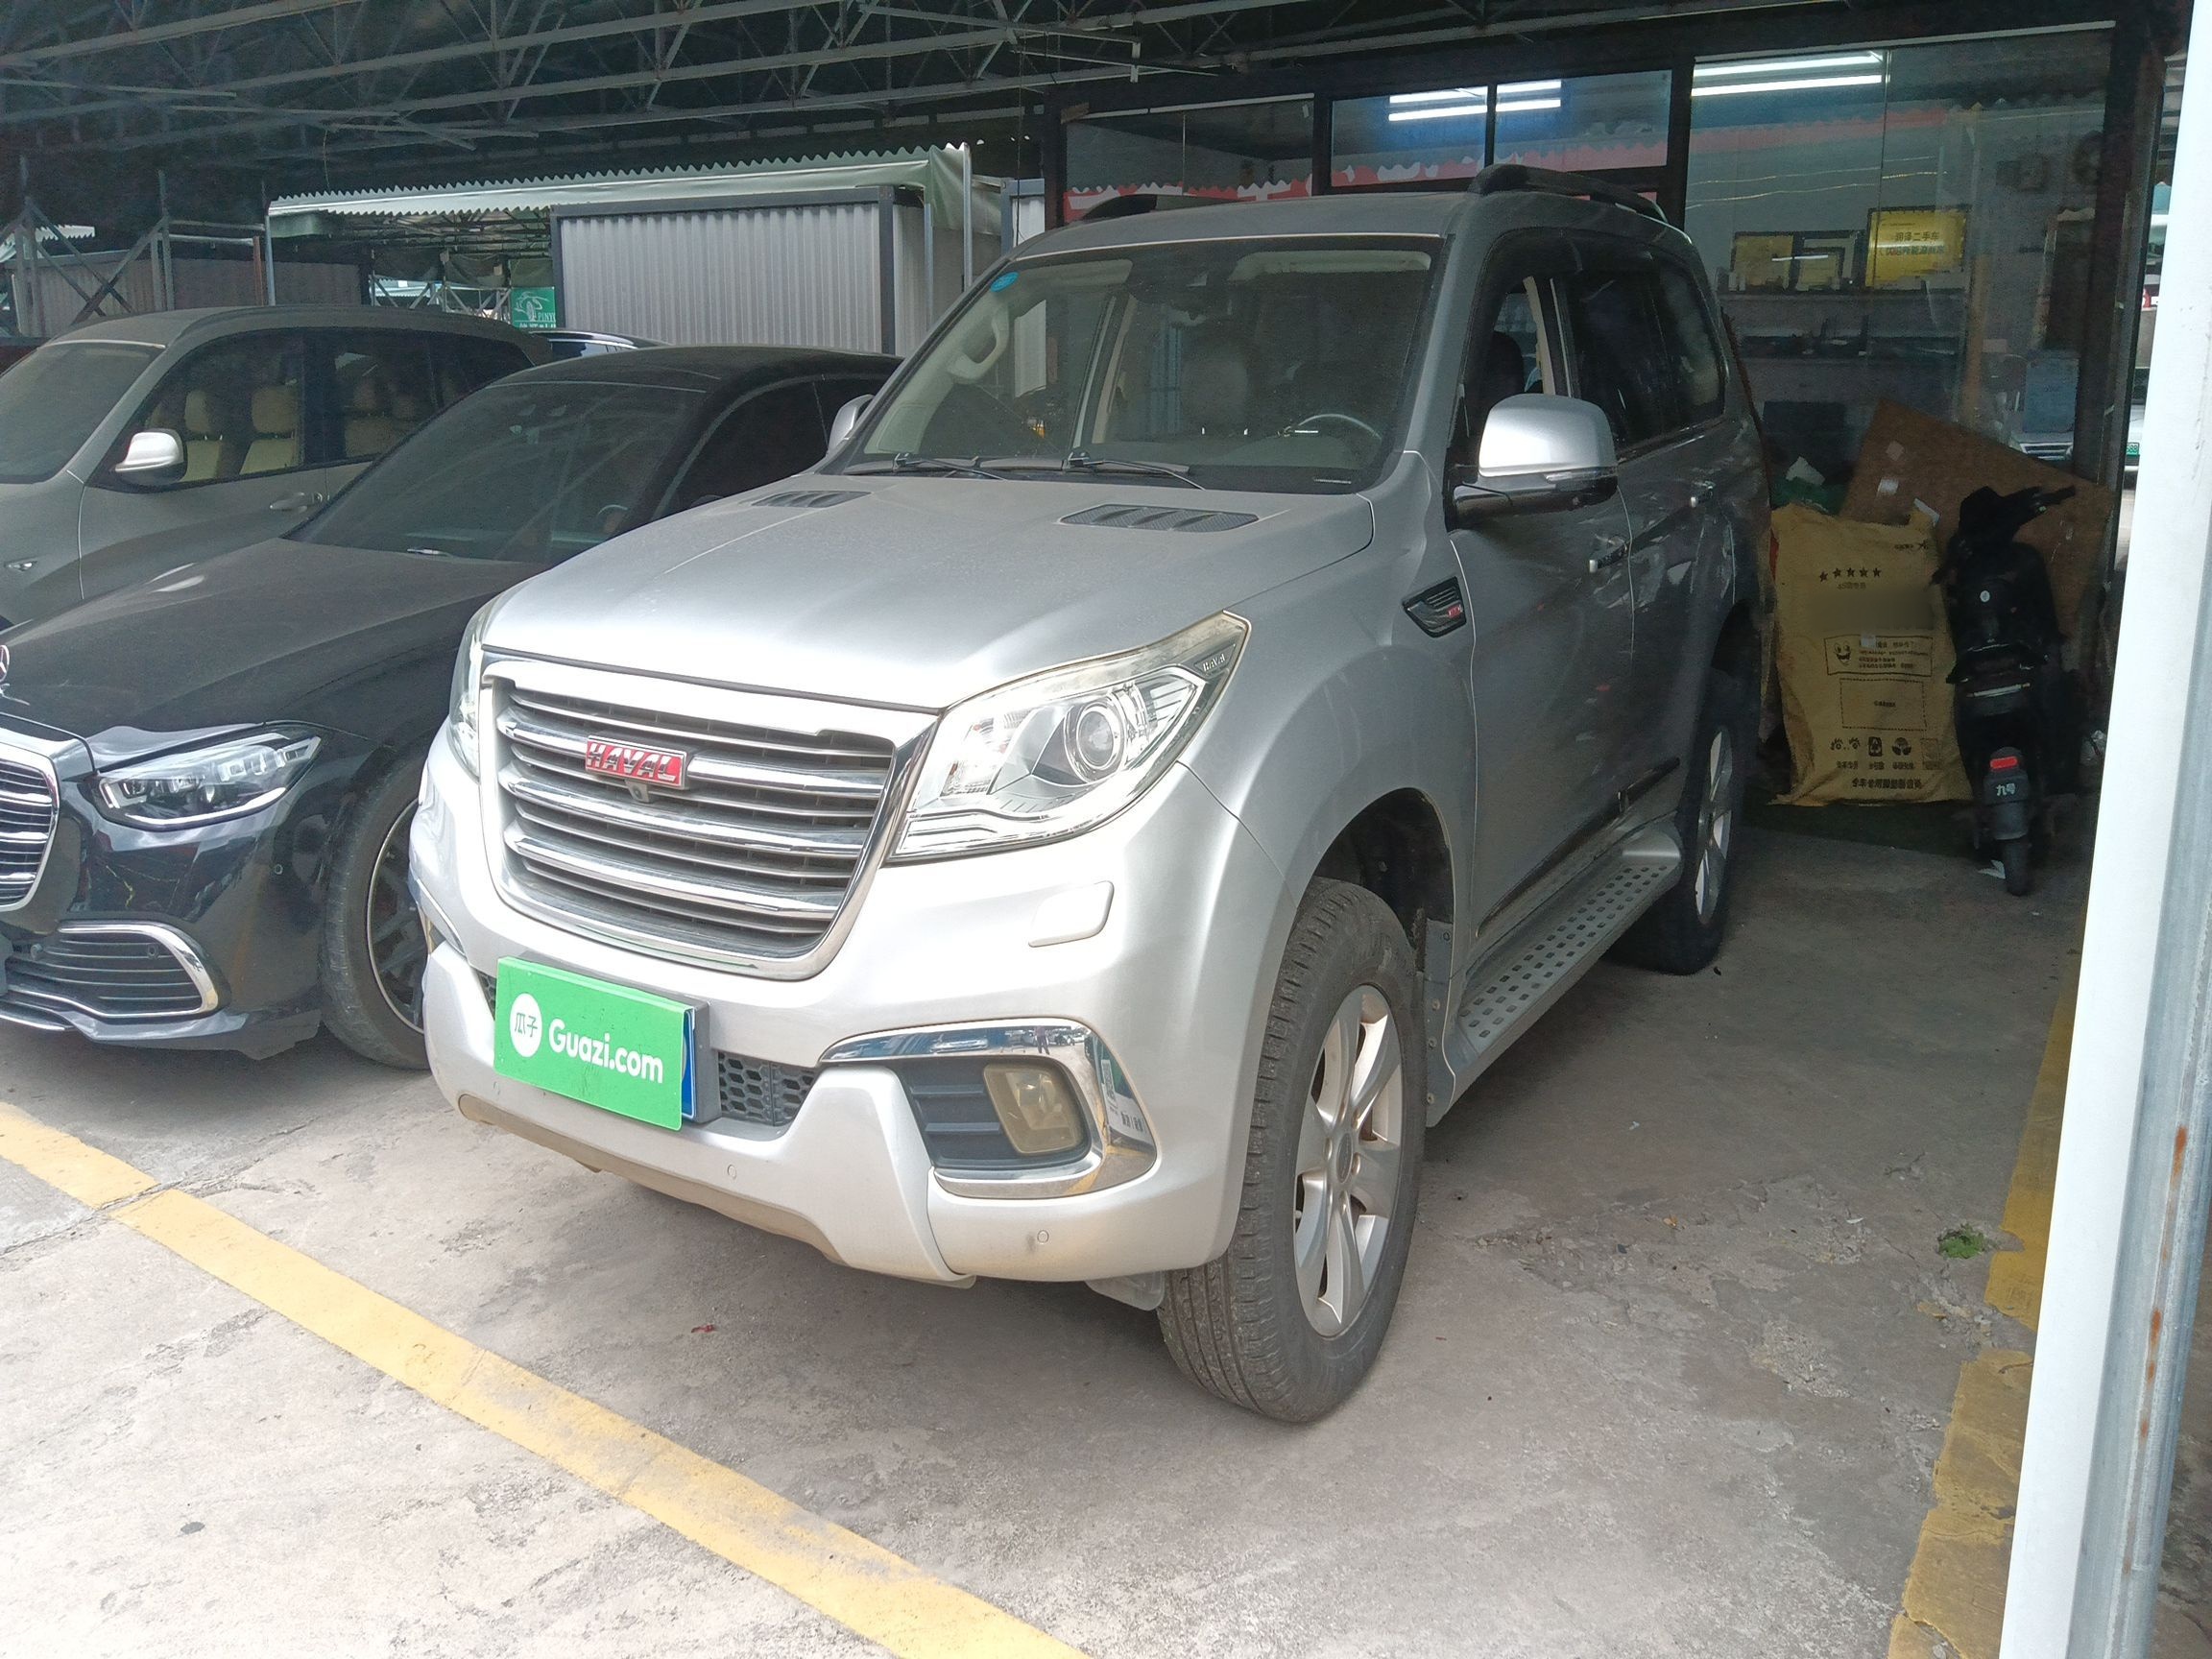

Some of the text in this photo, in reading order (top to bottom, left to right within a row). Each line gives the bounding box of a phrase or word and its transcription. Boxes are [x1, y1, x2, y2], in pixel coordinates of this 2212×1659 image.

[587, 742, 676, 782] HAVAL
[514, 1011, 539, 1038] 瓜子
[548, 1018, 663, 1084] Guazi.com
